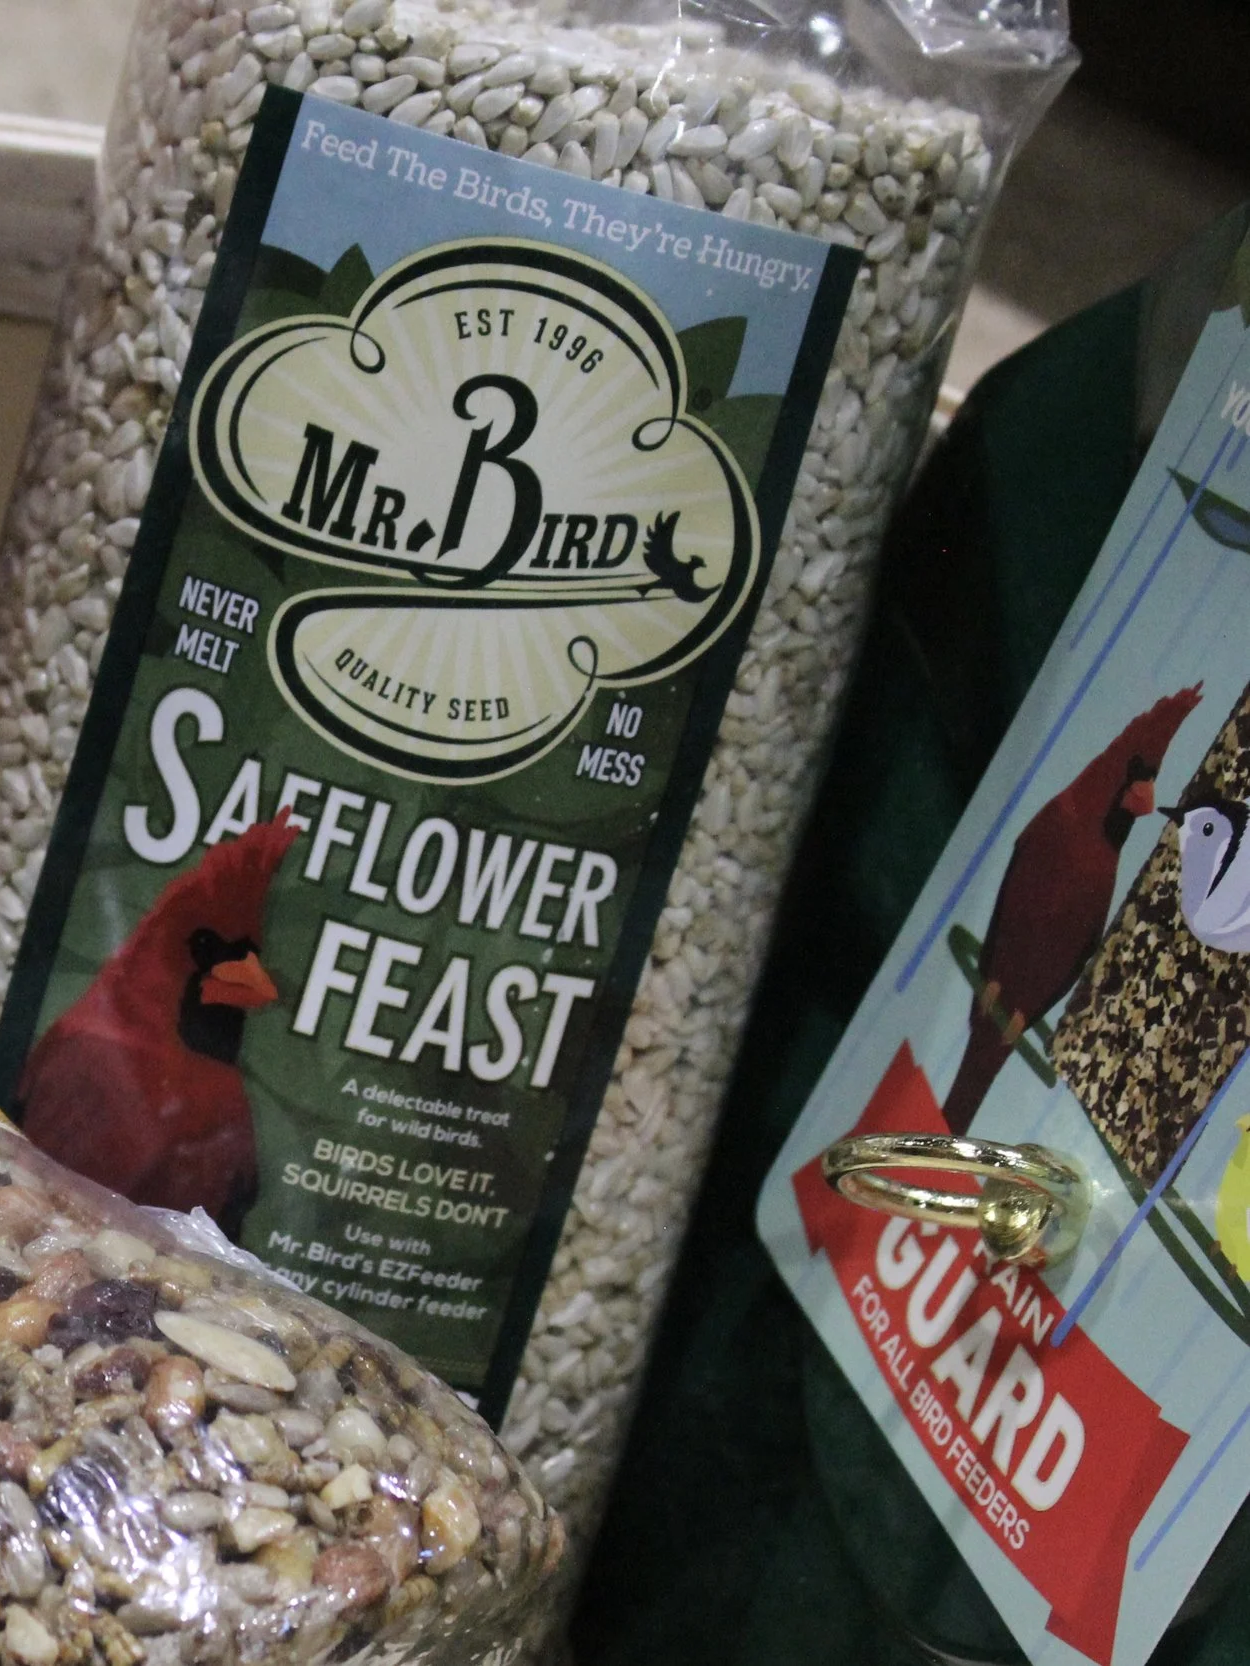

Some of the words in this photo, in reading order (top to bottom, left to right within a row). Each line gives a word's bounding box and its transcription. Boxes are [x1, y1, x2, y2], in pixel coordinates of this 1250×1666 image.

[301, 121, 376, 170] Feed
[386, 146, 447, 190] The
[454, 170, 553, 228] Birds,
[563, 199, 693, 261] They're
[697, 234, 813, 291] Hungry.
[454, 309, 516, 340] EST
[534, 318, 603, 374] 1996
[437, 374, 638, 590] BIRD
[179, 575, 260, 634] NEVER
[175, 623, 240, 674] MELT
[334, 648, 435, 714] QUALITY
[448, 697, 511, 721] SEED
[606, 702, 642, 738] NO
[576, 745, 645, 787] MESS
[123, 687, 618, 948] SAFFLOWER
[292, 920, 594, 1087] FEAST
[341, 1079, 359, 1095] A
[362, 1085, 463, 1120] delectable
[466, 1107, 510, 1127] treat
[356, 1108, 388, 1128] for
[391, 1117, 433, 1140] wild
[435, 1127, 483, 1148] birds.
[313, 1138, 395, 1176] BIRDS
[398, 1162, 468, 1190] LOVE
[468, 1172, 495, 1196] IT.
[282, 1164, 433, 1218] SQUIRRELS
[435, 1202, 509, 1230] DON'T
[345, 1224, 383, 1246] Use
[389, 1237, 431, 1255] with
[322, 1279, 415, 1310] cylinder
[415, 1295, 488, 1320] feeder
[378, 1259, 483, 1292] EZFeeder
[876, 1216, 1085, 1511] GUARD
[852, 1275, 888, 1341] FOR
[881, 1334, 912, 1392] ALL
[909, 1376, 953, 1447] BIRD
[945, 1435, 1031, 1551] FEEDERS
